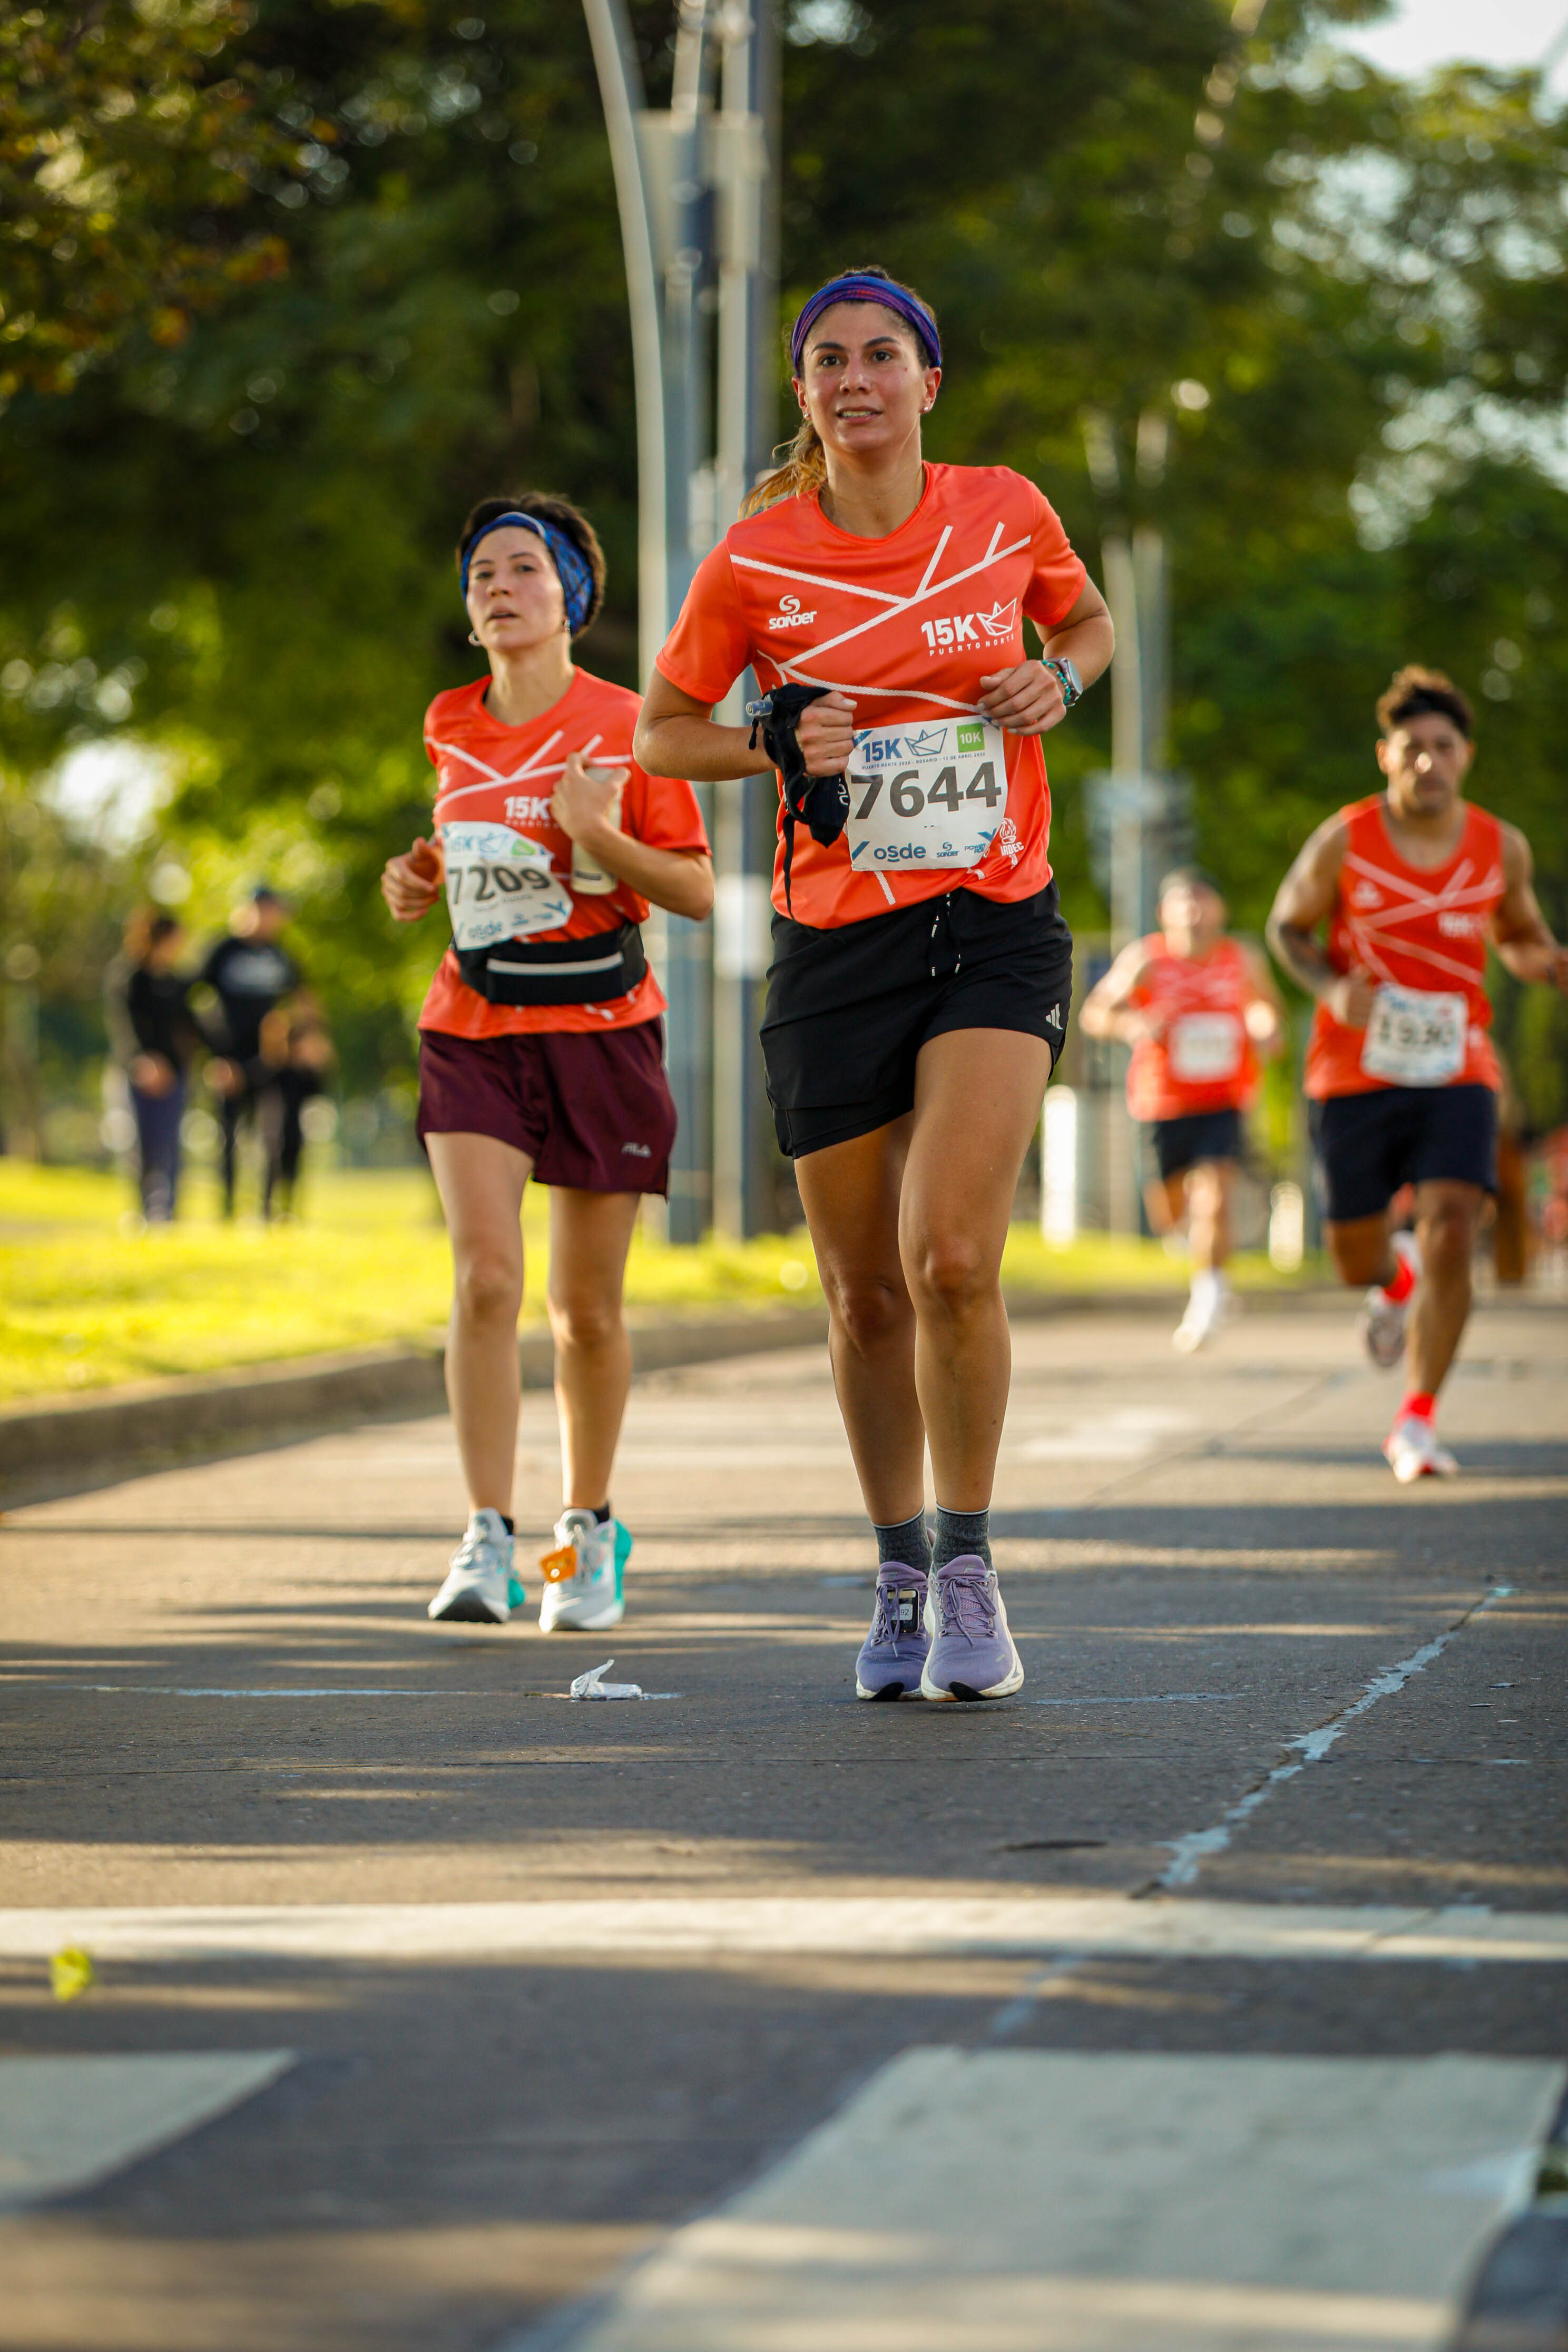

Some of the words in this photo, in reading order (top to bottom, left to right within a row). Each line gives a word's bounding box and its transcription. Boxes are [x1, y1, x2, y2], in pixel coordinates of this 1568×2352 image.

[921, 614, 979, 648] 15K
[929, 642, 981, 656] PUERTO
[985, 633, 1014, 647] NORTE
[959, 731, 982, 744] 10K
[862, 738, 903, 762] 15K
[851, 761, 1002, 820] 7644
[504, 796, 551, 820] 15K
[874, 842, 926, 862] osde
[448, 866, 550, 905] 7209
